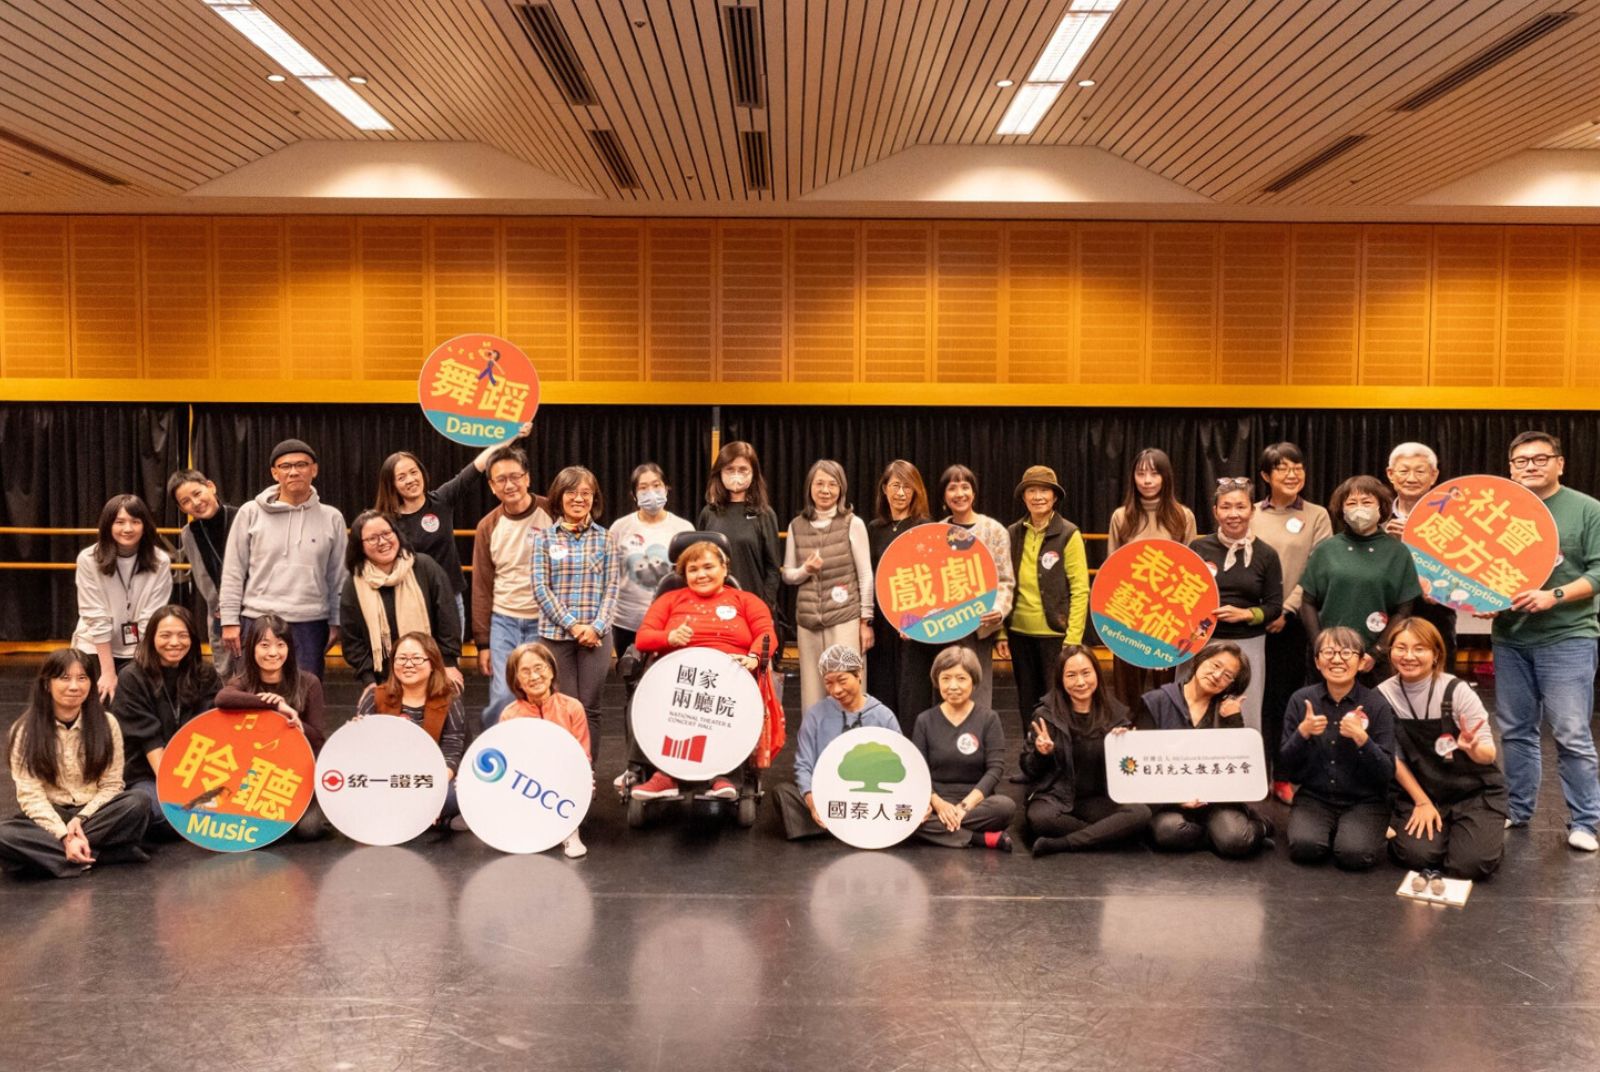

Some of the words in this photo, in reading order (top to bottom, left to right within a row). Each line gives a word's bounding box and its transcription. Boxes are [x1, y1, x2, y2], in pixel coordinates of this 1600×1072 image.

[431, 358, 530, 423] 舞蹈
[446, 416, 505, 439] Dance
[1464, 488, 1543, 556] 社會
[1413, 511, 1529, 598] 處方箋
[888, 553, 987, 612] 戲劇
[1130, 544, 1209, 616] 表演
[1411, 551, 1440, 573] Social
[1441, 567, 1504, 607] Prescription
[922, 600, 988, 638] Drama
[1104, 579, 1185, 645] 藝術
[1101, 624, 1153, 655] Performing
[1153, 649, 1174, 663] Arts
[676, 664, 719, 689] 國家
[671, 687, 737, 718] 兩廳院
[172, 732, 303, 821] 聆聽
[347, 774, 434, 788] 統一證券
[1143, 761, 1252, 776] 日月光文教基金會
[511, 769, 576, 819] TDCC
[828, 800, 913, 822] 國泰人壽
[186, 813, 259, 843] Music
